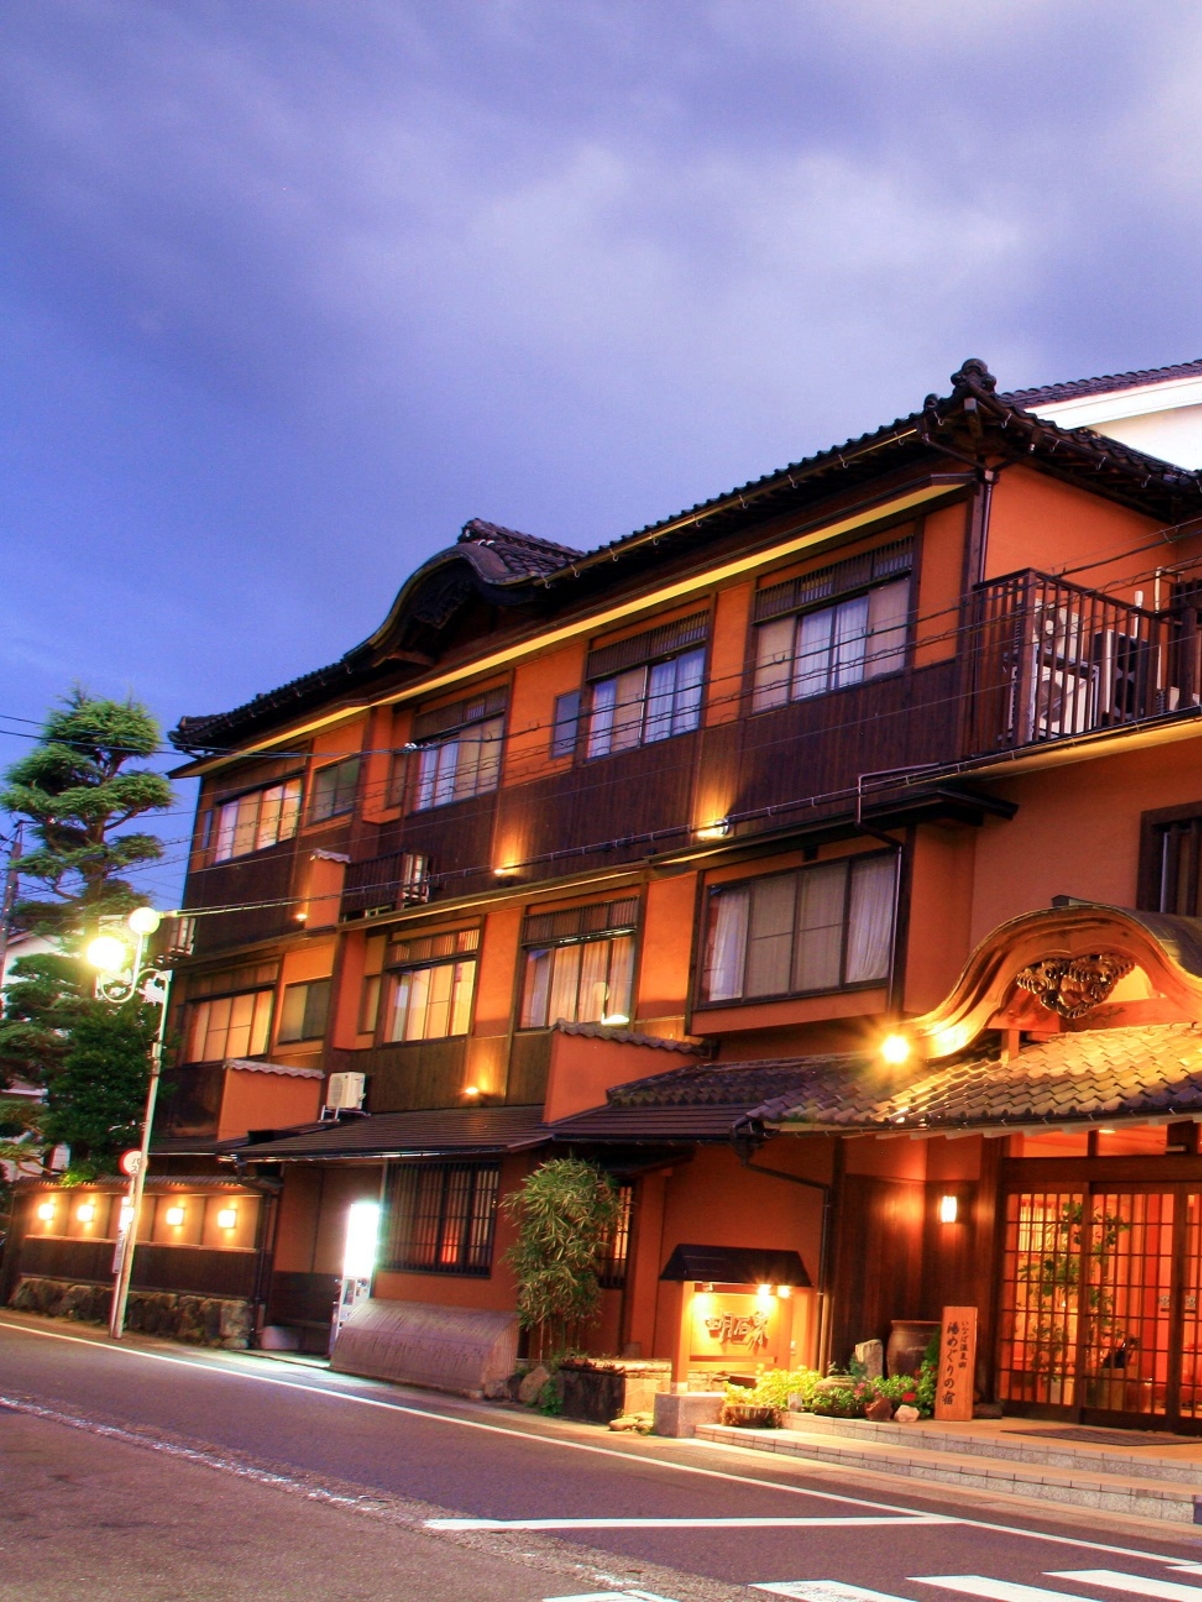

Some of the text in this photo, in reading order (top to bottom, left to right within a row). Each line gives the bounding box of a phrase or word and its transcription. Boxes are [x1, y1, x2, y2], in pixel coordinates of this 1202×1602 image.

[942, 1321, 959, 1405] 湯めぐりの宿
